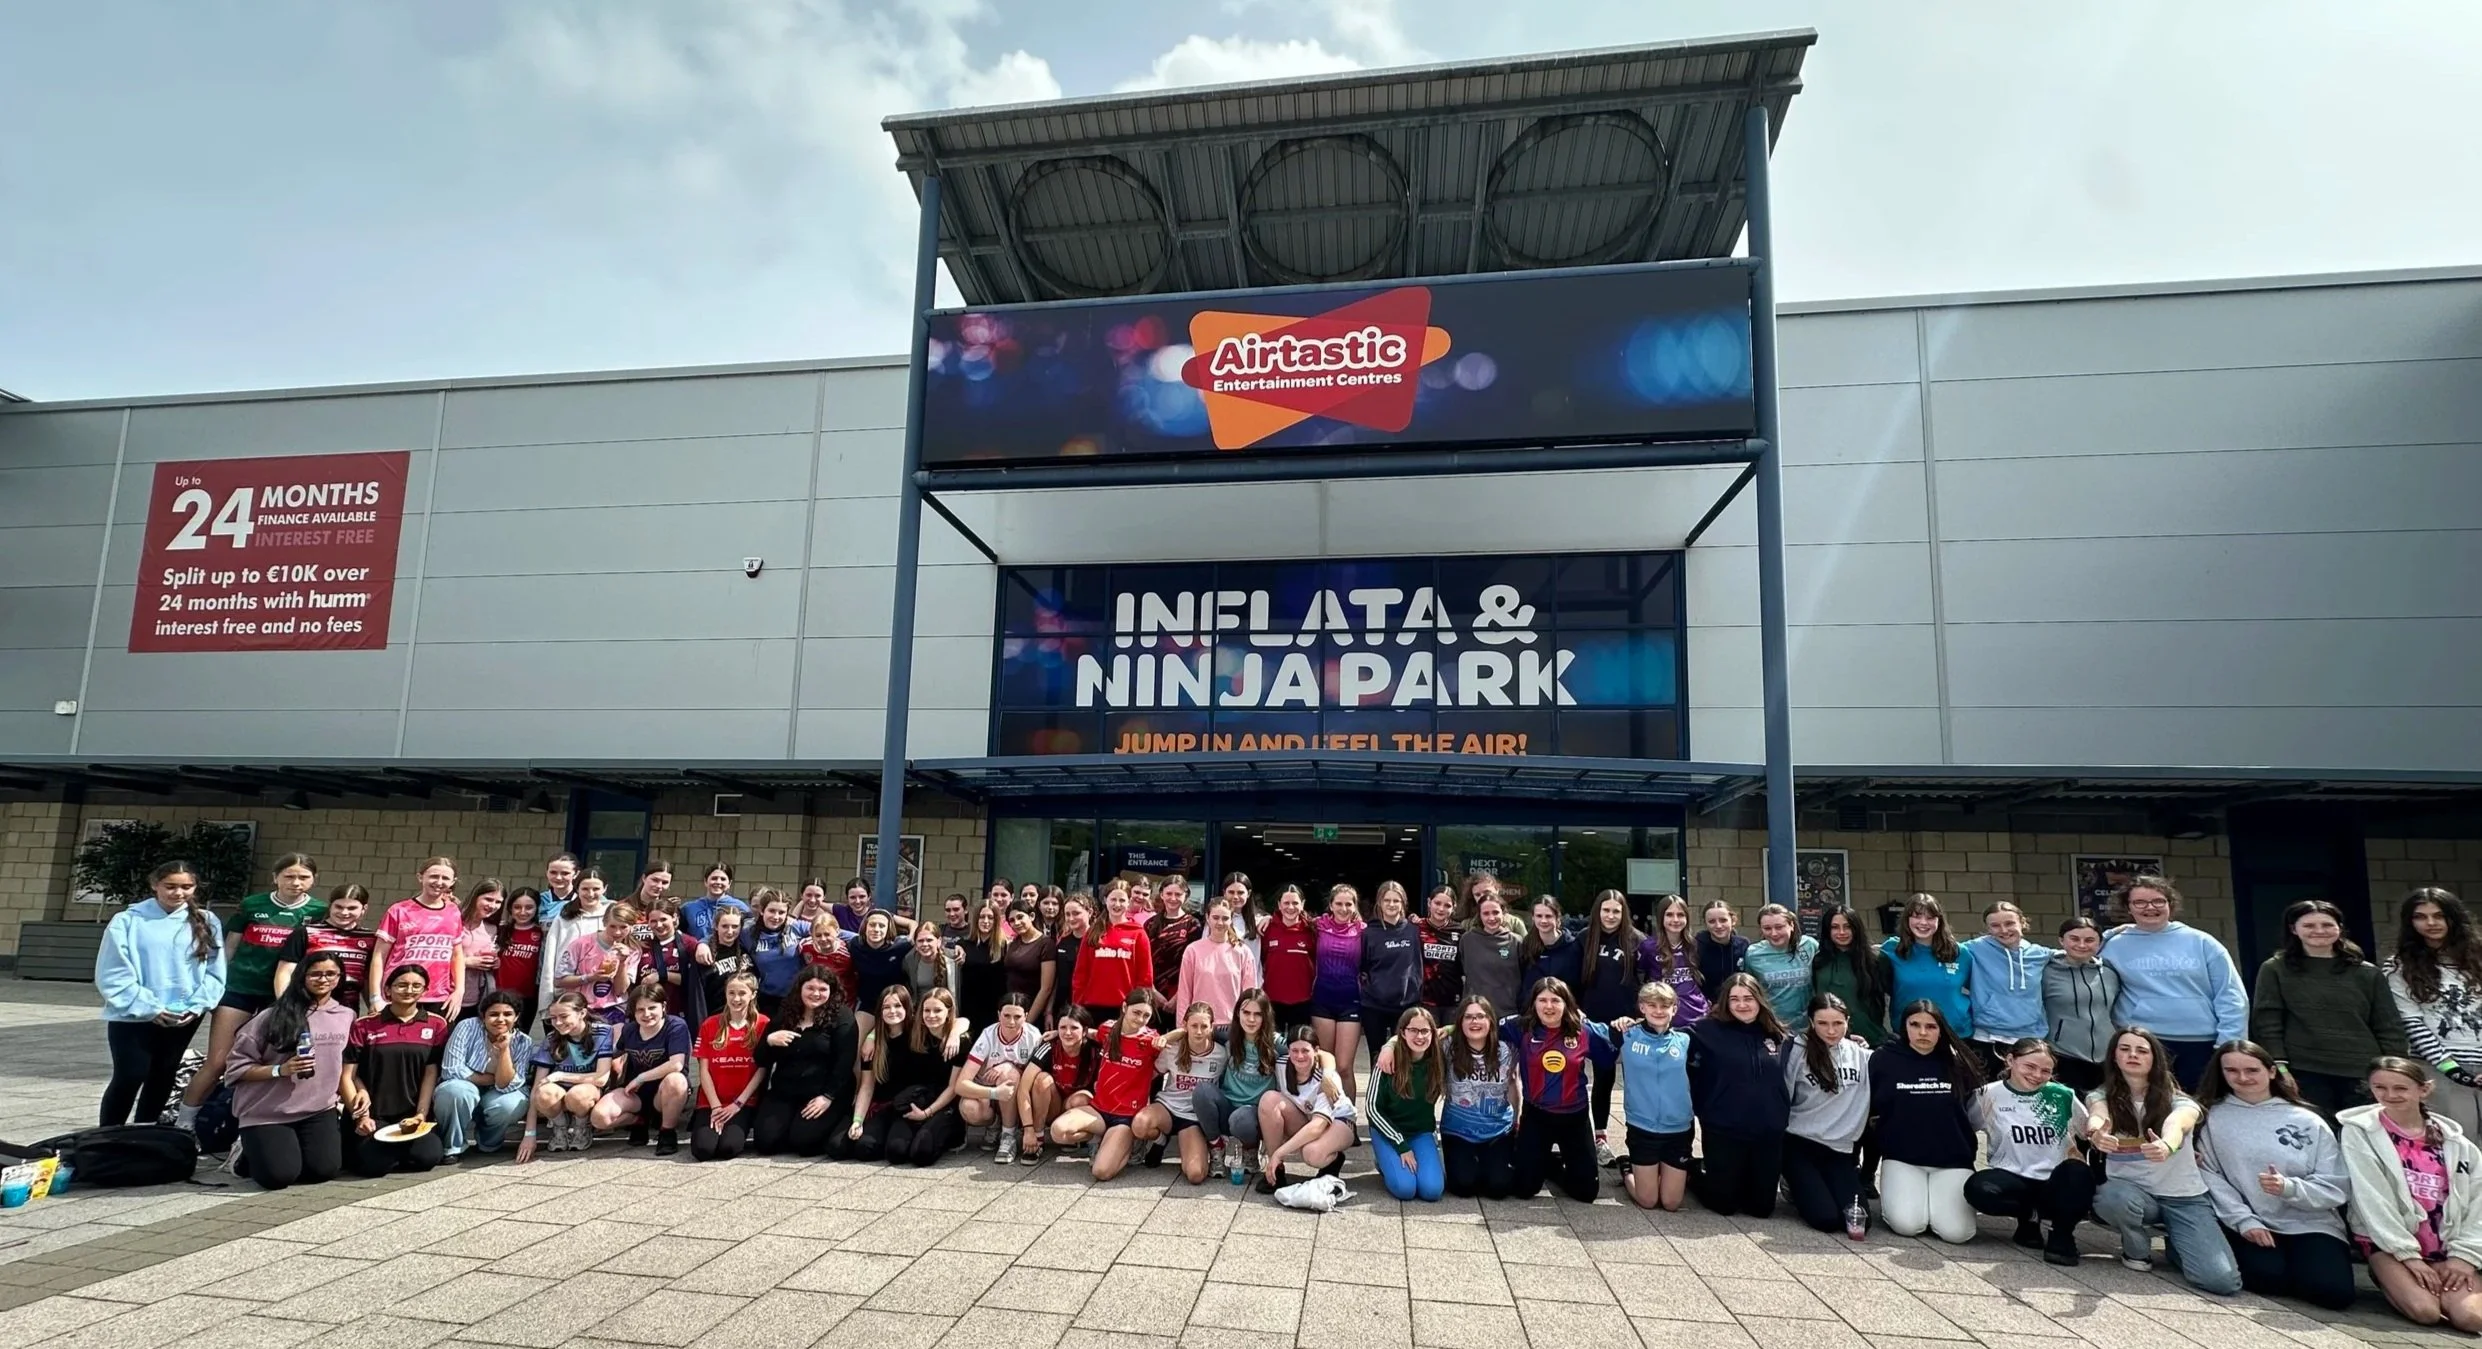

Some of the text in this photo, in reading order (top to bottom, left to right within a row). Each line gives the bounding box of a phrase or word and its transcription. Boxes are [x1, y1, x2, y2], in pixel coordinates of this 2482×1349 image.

[1210, 326, 1407, 376] Airtastic
[1213, 372, 1402, 392] Entertainment Centres
[175, 475, 201, 487] Up to
[260, 481, 379, 508] MONTHS
[165, 487, 254, 550] 24
[257, 511, 376, 525] FINANCE AVAILABLE
[255, 529, 374, 547] INTEREST FREE
[163, 565, 369, 589] Split up to €10K over
[159, 595, 182, 611] 24
[188, 593, 257, 611] months
[263, 591, 304, 609] with
[155, 616, 362, 636] interest free and no fees
[1115, 584, 1538, 649] INFLATA &
[1076, 649, 1577, 708] NINJA PARK
[1114, 732, 1197, 755] JUMP
[1202, 733, 1232, 752] IN
[1238, 733, 1306, 752] AND
[1391, 733, 1456, 753] THE
[1461, 733, 1528, 756] AIR!
[1470, 859, 1497, 867] NEXT
[1426, 943, 1456, 953] SPORTS
[1631, 1041, 1650, 1056] CITY
[2011, 1124, 2056, 1145] DRIP
